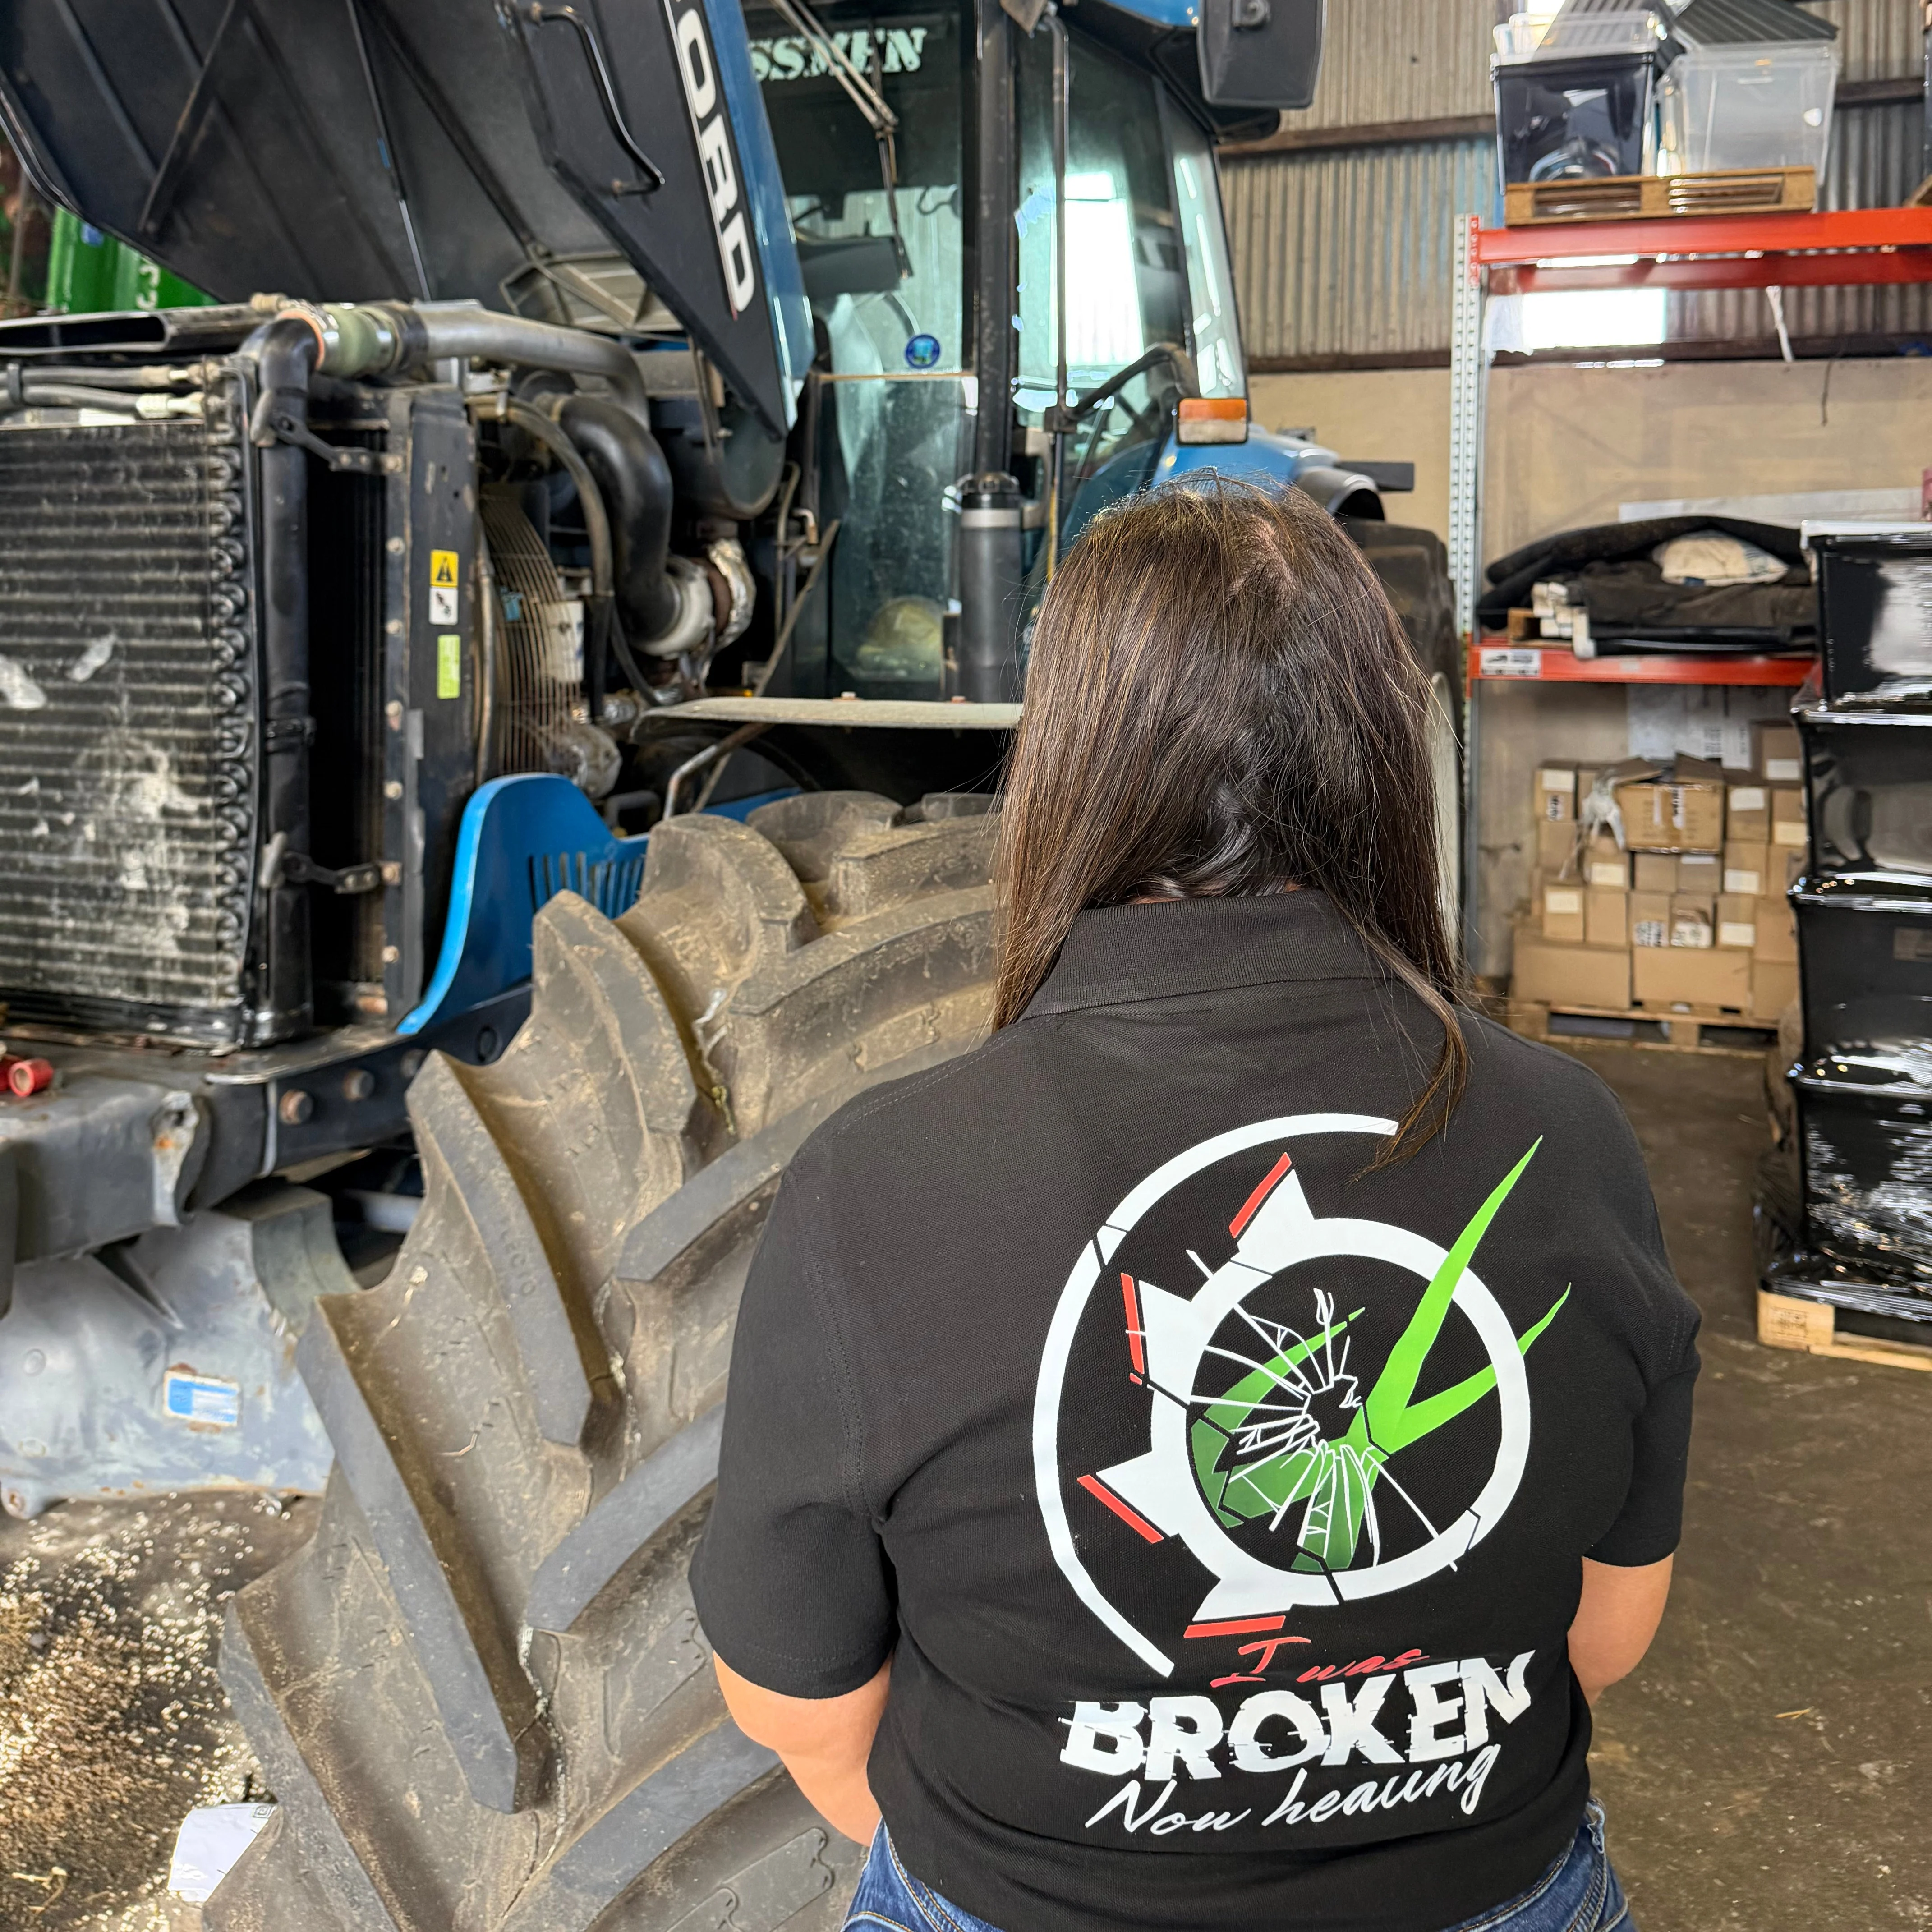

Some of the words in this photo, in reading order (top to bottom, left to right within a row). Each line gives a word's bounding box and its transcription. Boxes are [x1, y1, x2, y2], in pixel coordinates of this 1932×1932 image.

[676, 0, 755, 312] ORD
[1210, 1636, 1311, 1688] I
[1296, 1648, 1430, 1683] was
[1058, 1650, 1536, 1781] BROKEN
[1085, 1779, 1251, 1835] Now
